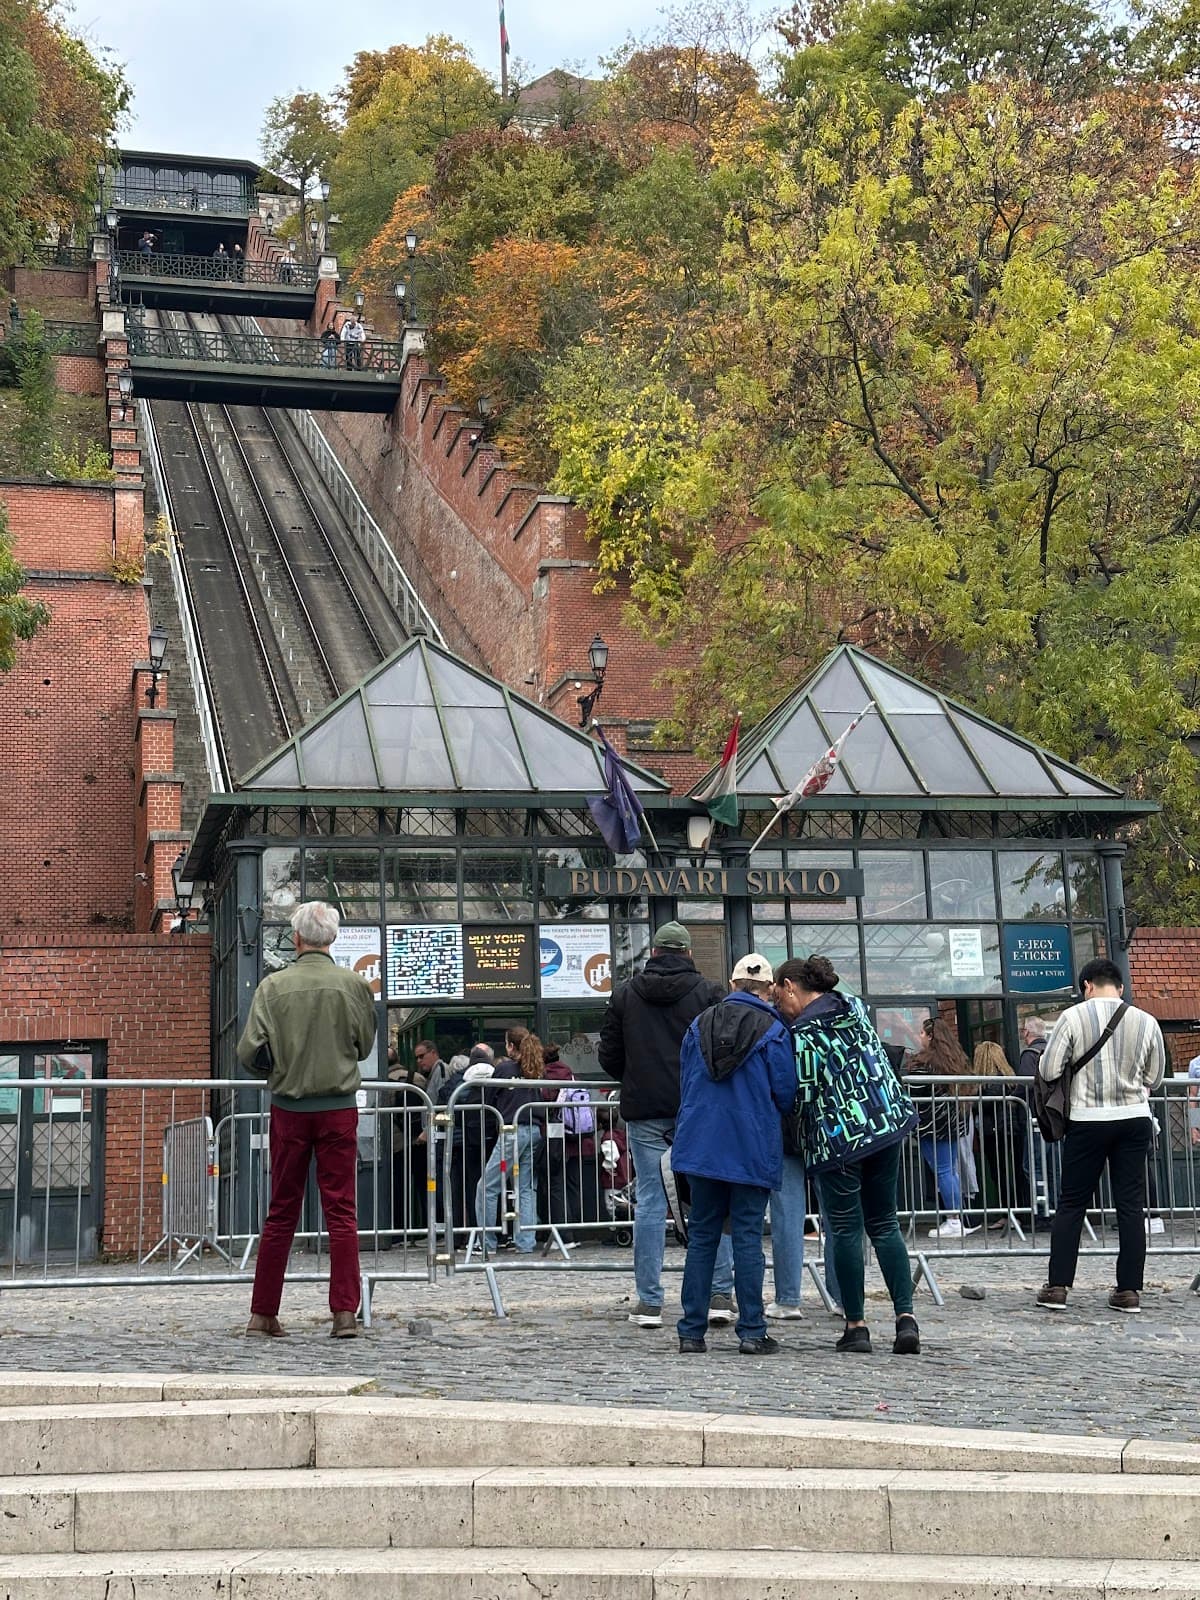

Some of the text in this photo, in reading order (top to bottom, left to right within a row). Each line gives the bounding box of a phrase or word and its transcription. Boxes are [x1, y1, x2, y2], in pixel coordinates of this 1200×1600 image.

[746, 865, 841, 896] SIKLÓ
[468, 934, 526, 945] BUY YOUR
[1018, 939, 1055, 950] E-JEGY
[1013, 951, 1061, 961] E-TICKET
